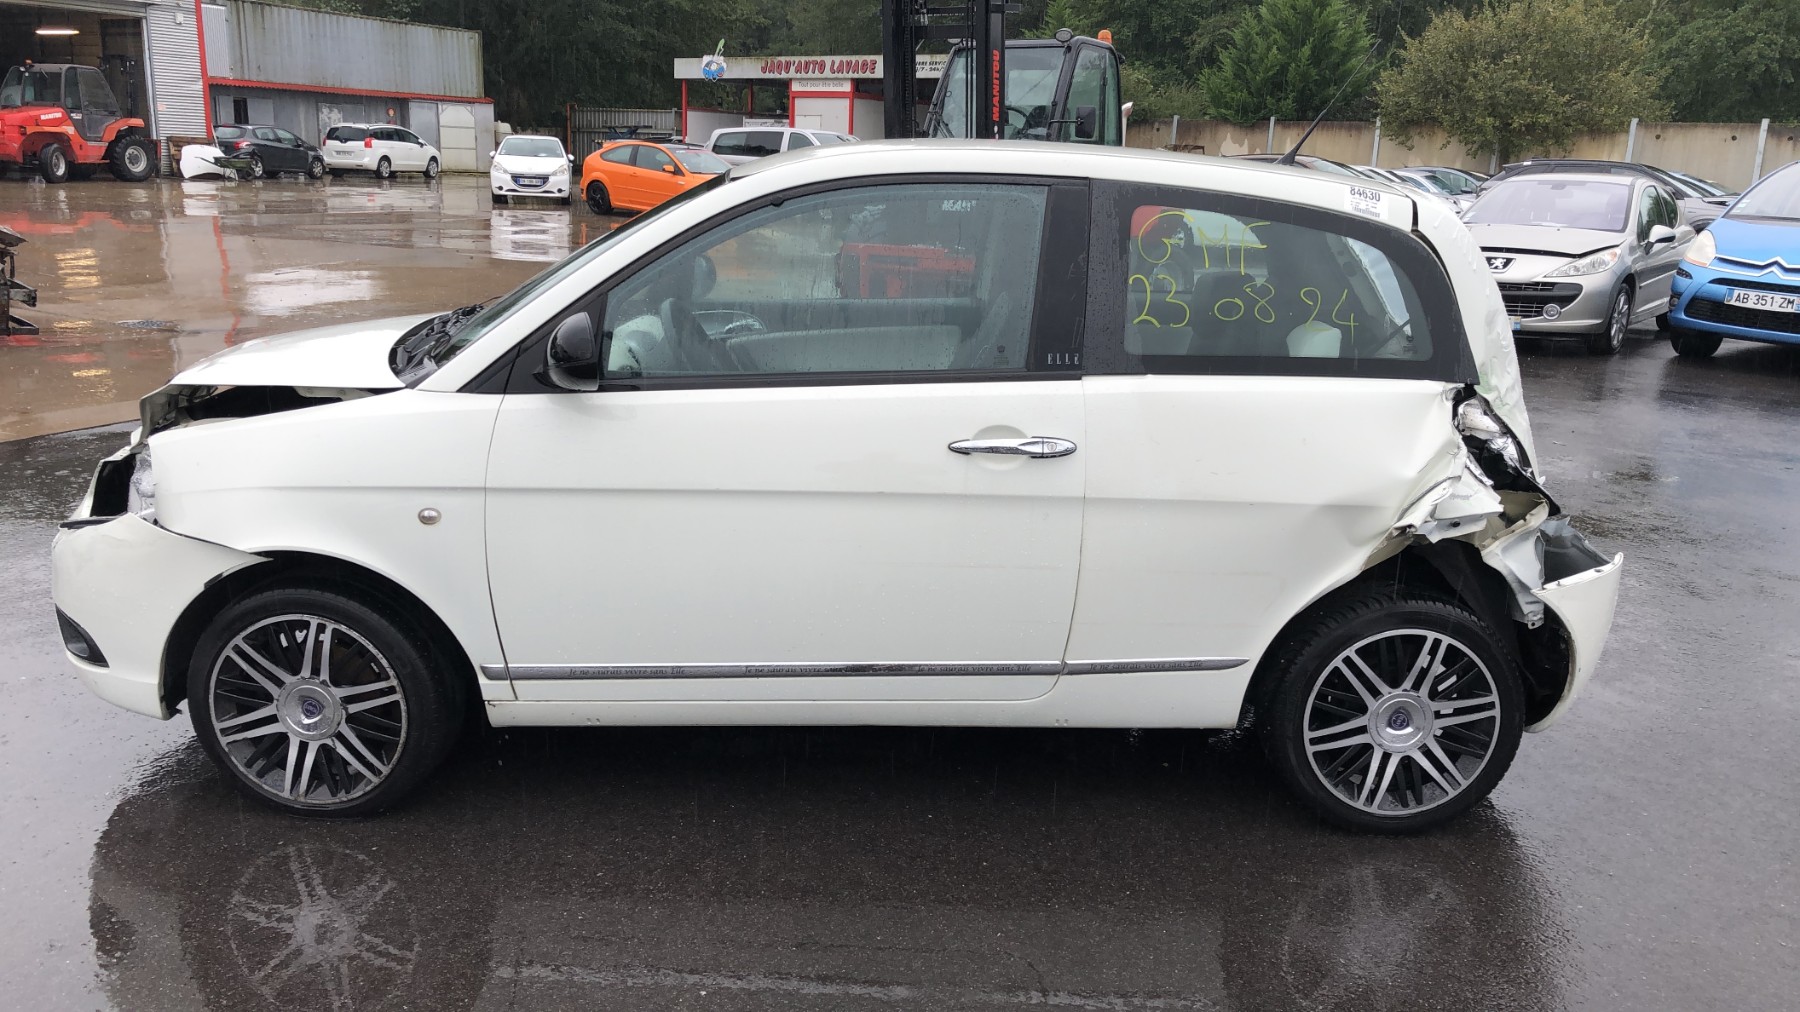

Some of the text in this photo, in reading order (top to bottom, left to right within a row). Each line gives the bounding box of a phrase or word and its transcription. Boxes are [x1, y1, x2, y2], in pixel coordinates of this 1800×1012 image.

[760, 59, 877, 75] JAQU'AUTO LAVAGE
[992, 49, 1000, 121] MANITOU
[1350, 186, 1381, 202] 84630
